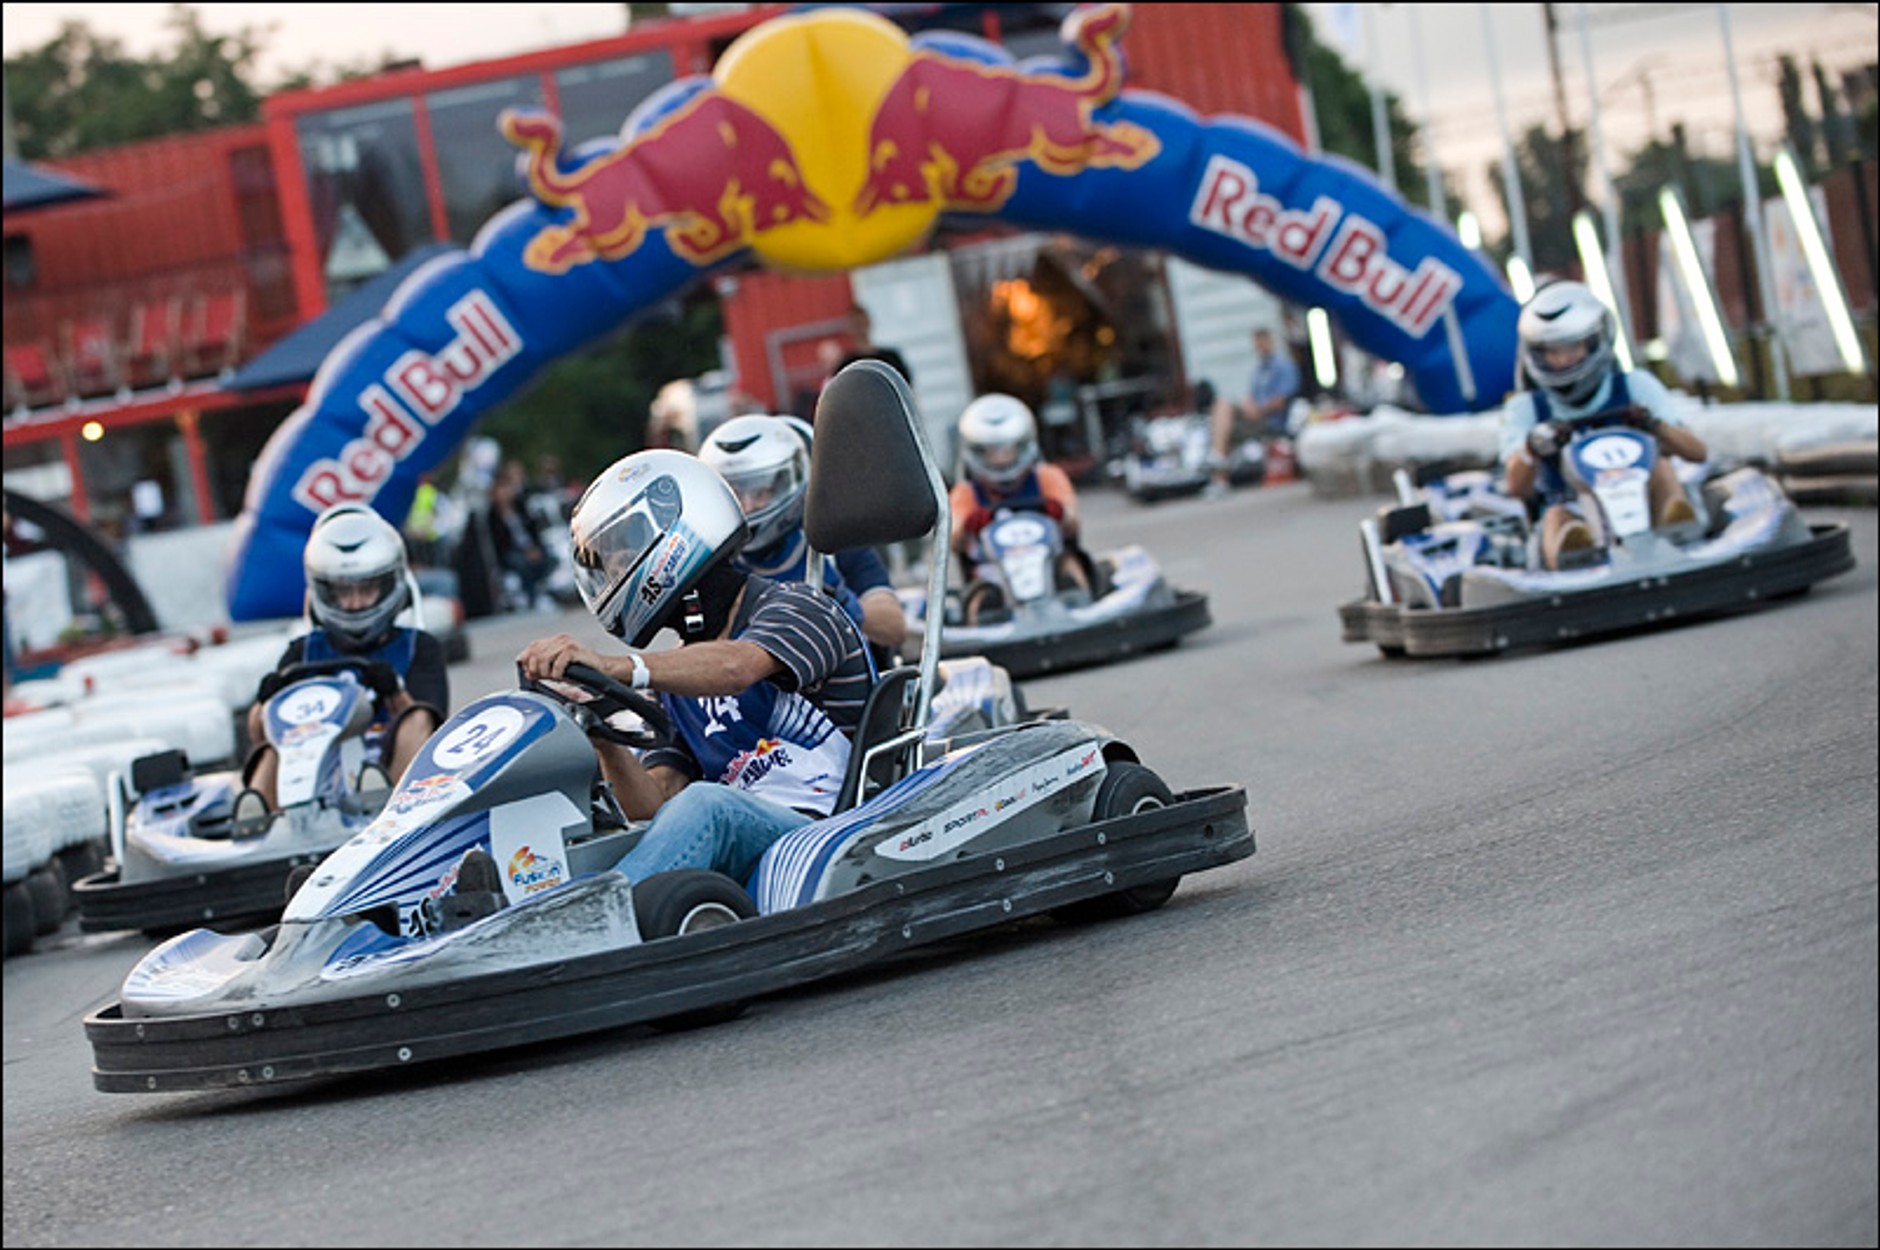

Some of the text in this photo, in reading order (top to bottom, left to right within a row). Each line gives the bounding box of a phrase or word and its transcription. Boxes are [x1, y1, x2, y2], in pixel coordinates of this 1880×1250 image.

[1197, 164, 1454, 331] Red Bull
[301, 297, 515, 508] Red Bull
[296, 699, 325, 719] 34
[446, 723, 508, 756] 24
